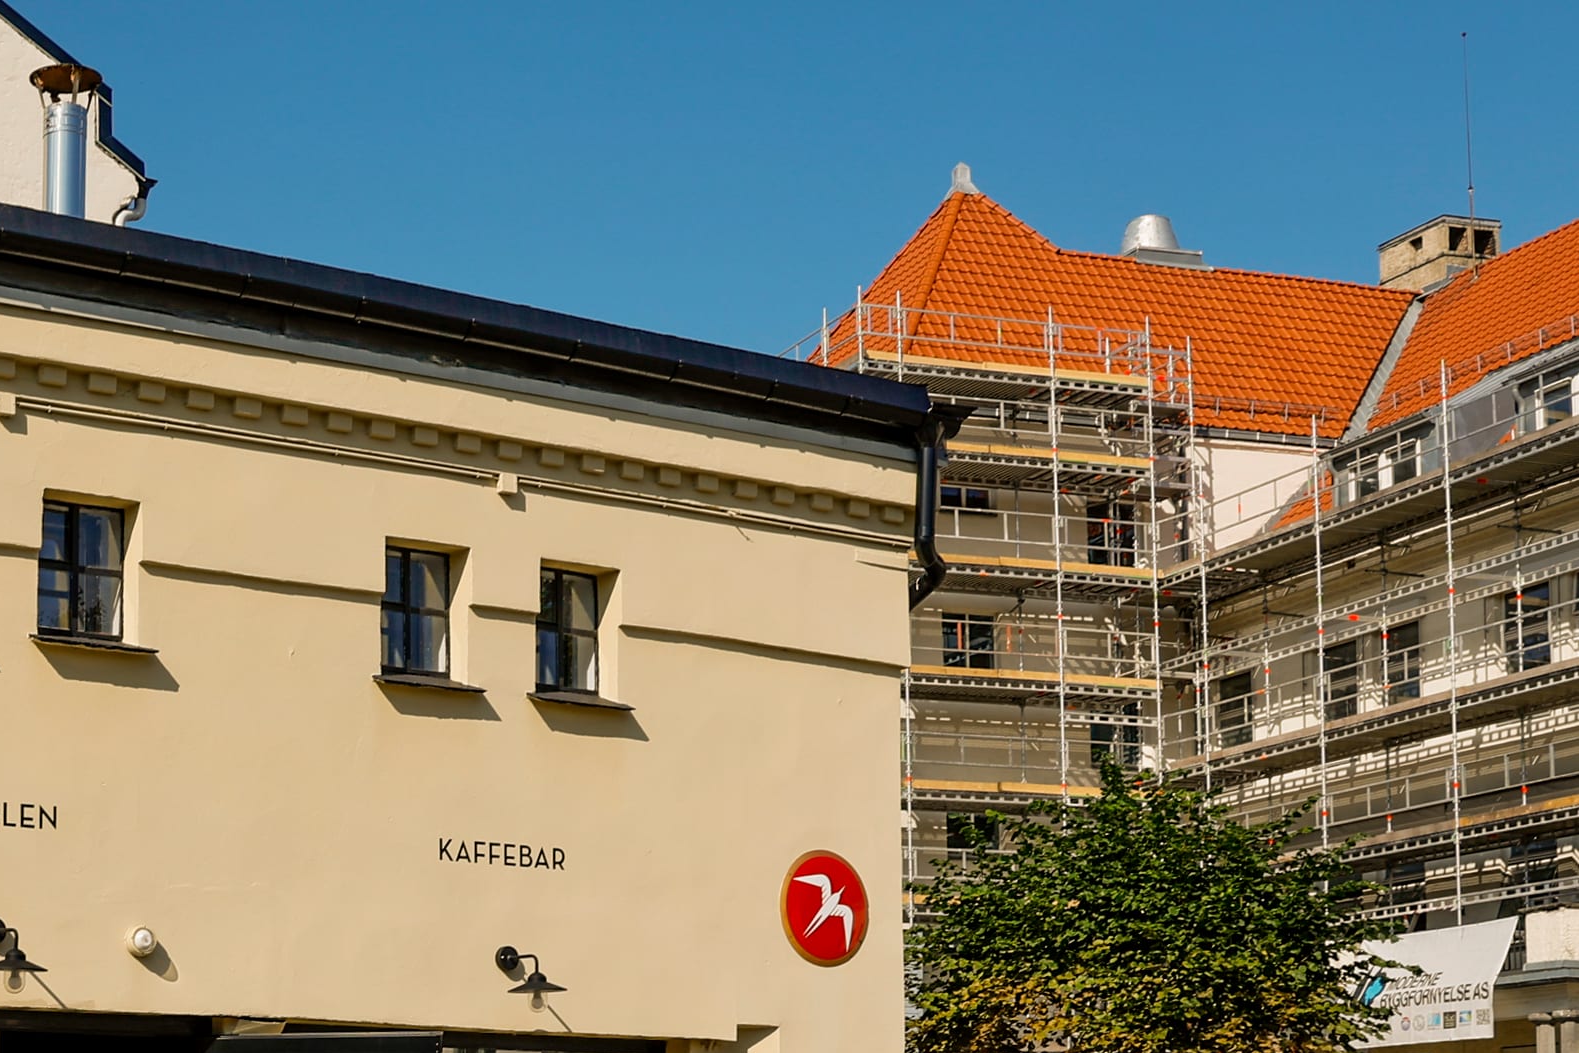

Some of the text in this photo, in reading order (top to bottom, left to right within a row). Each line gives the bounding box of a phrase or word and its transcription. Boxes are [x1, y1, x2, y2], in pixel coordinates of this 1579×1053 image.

[439, 838, 565, 870] KAFFEBAR
[1380, 982, 1489, 1009] BYGGFORNYELSE AS
